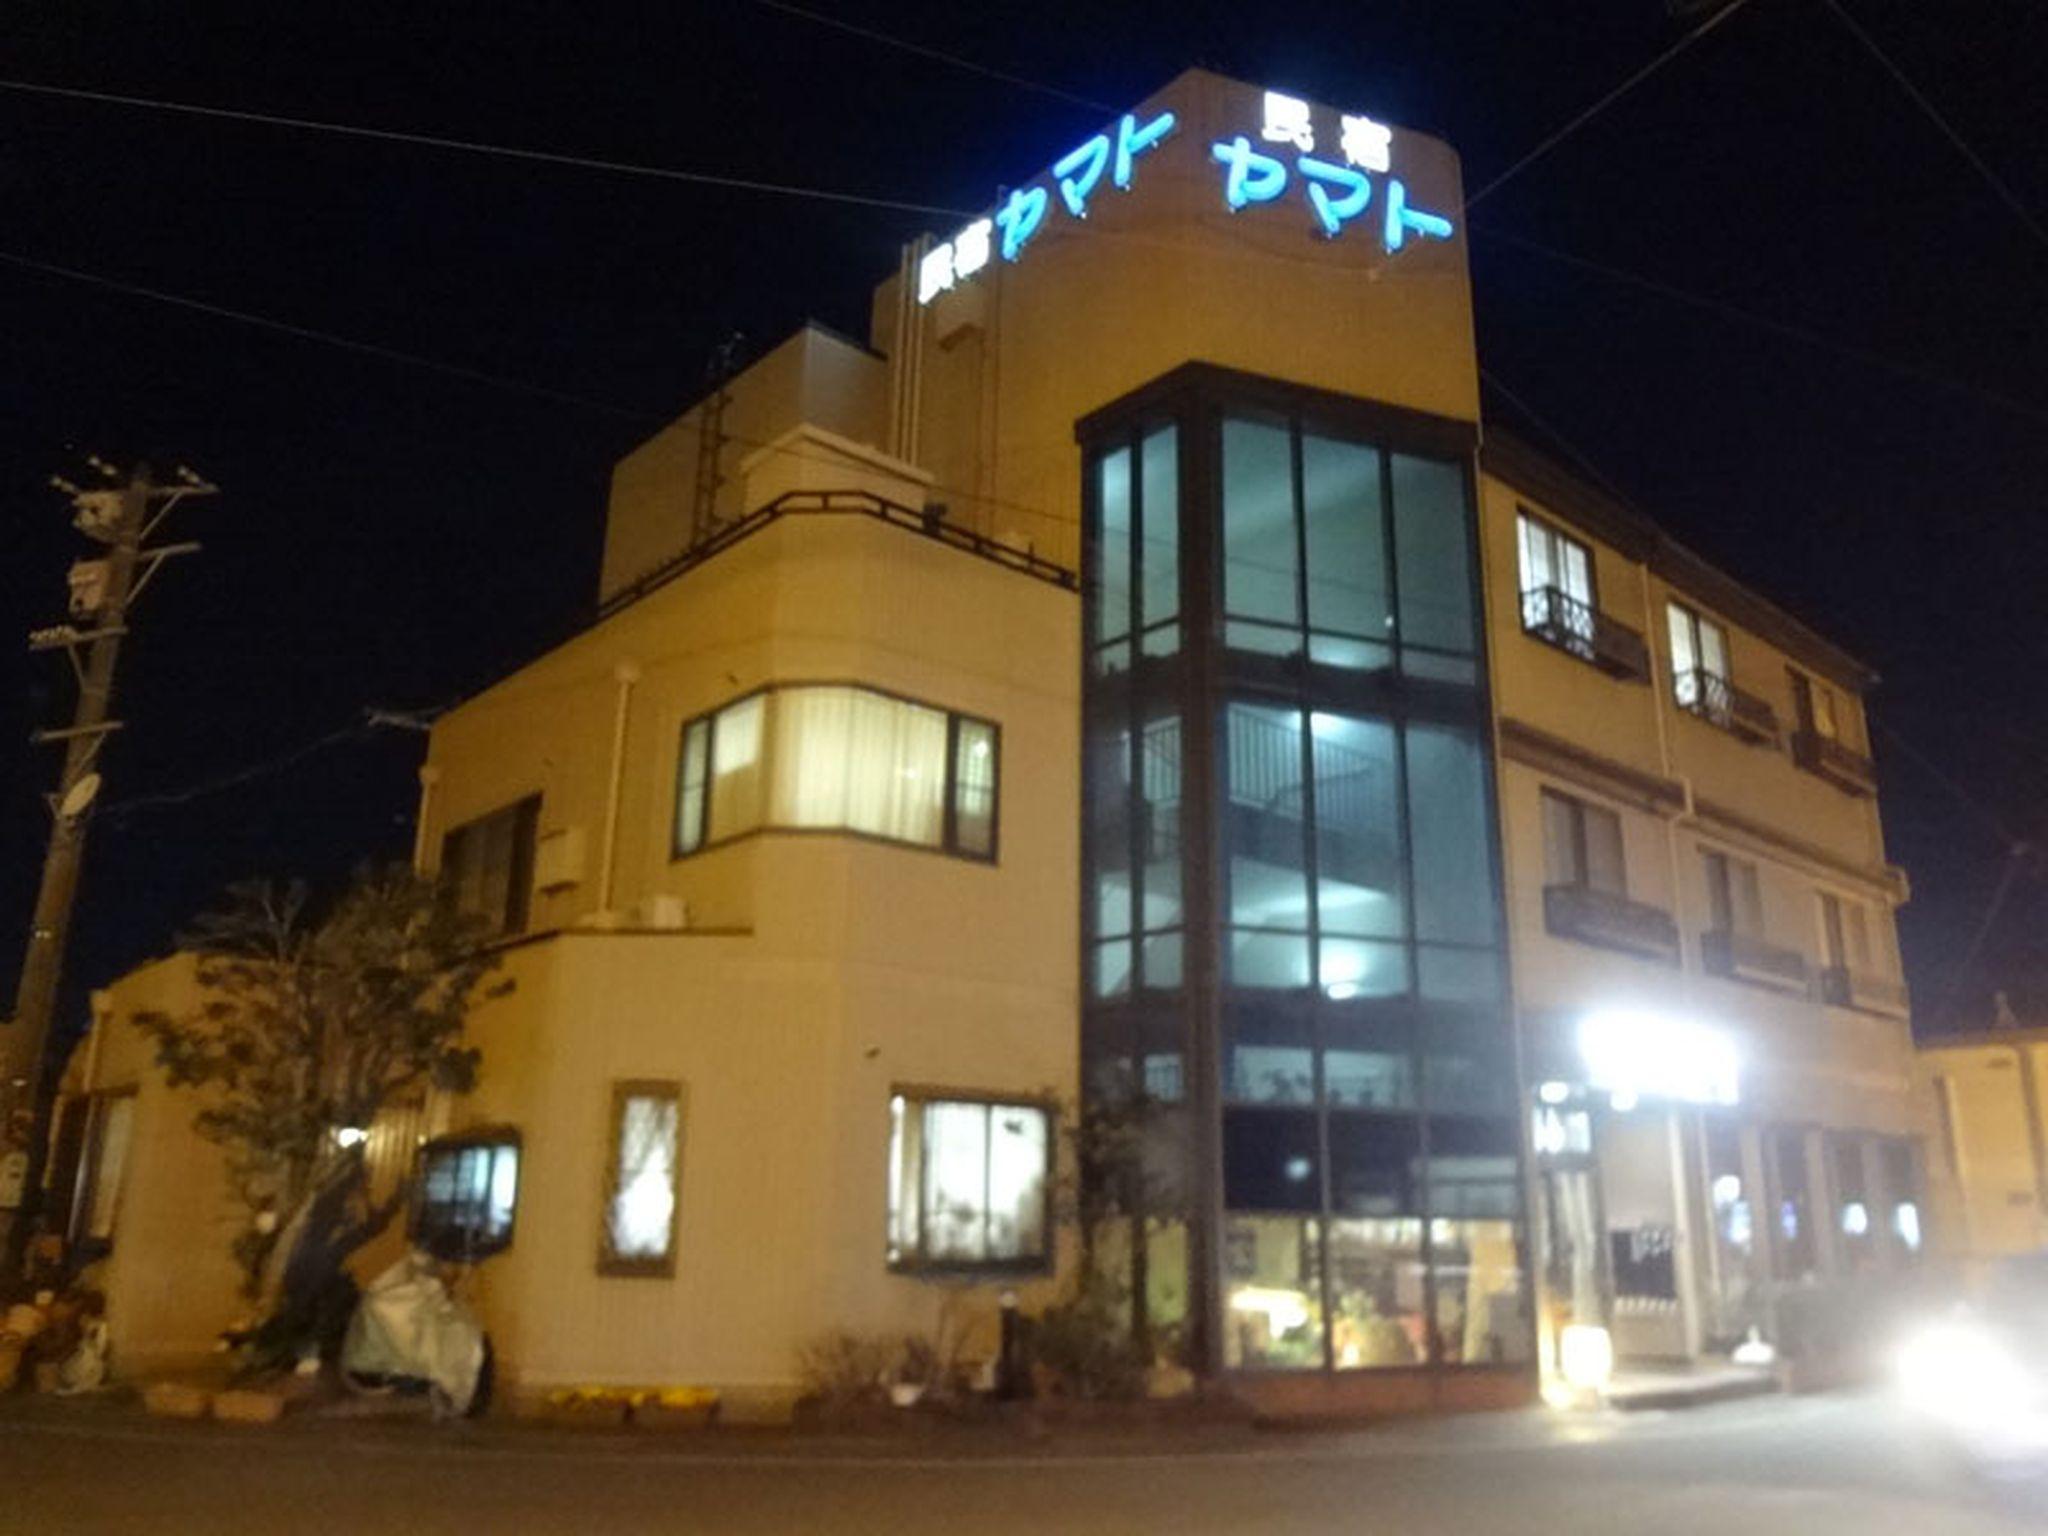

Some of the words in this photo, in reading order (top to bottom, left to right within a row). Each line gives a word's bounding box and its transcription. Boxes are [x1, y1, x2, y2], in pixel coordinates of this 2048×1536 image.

[996, 111, 1176, 262] ヤマト
[1212, 136, 1454, 254] ヤマト
